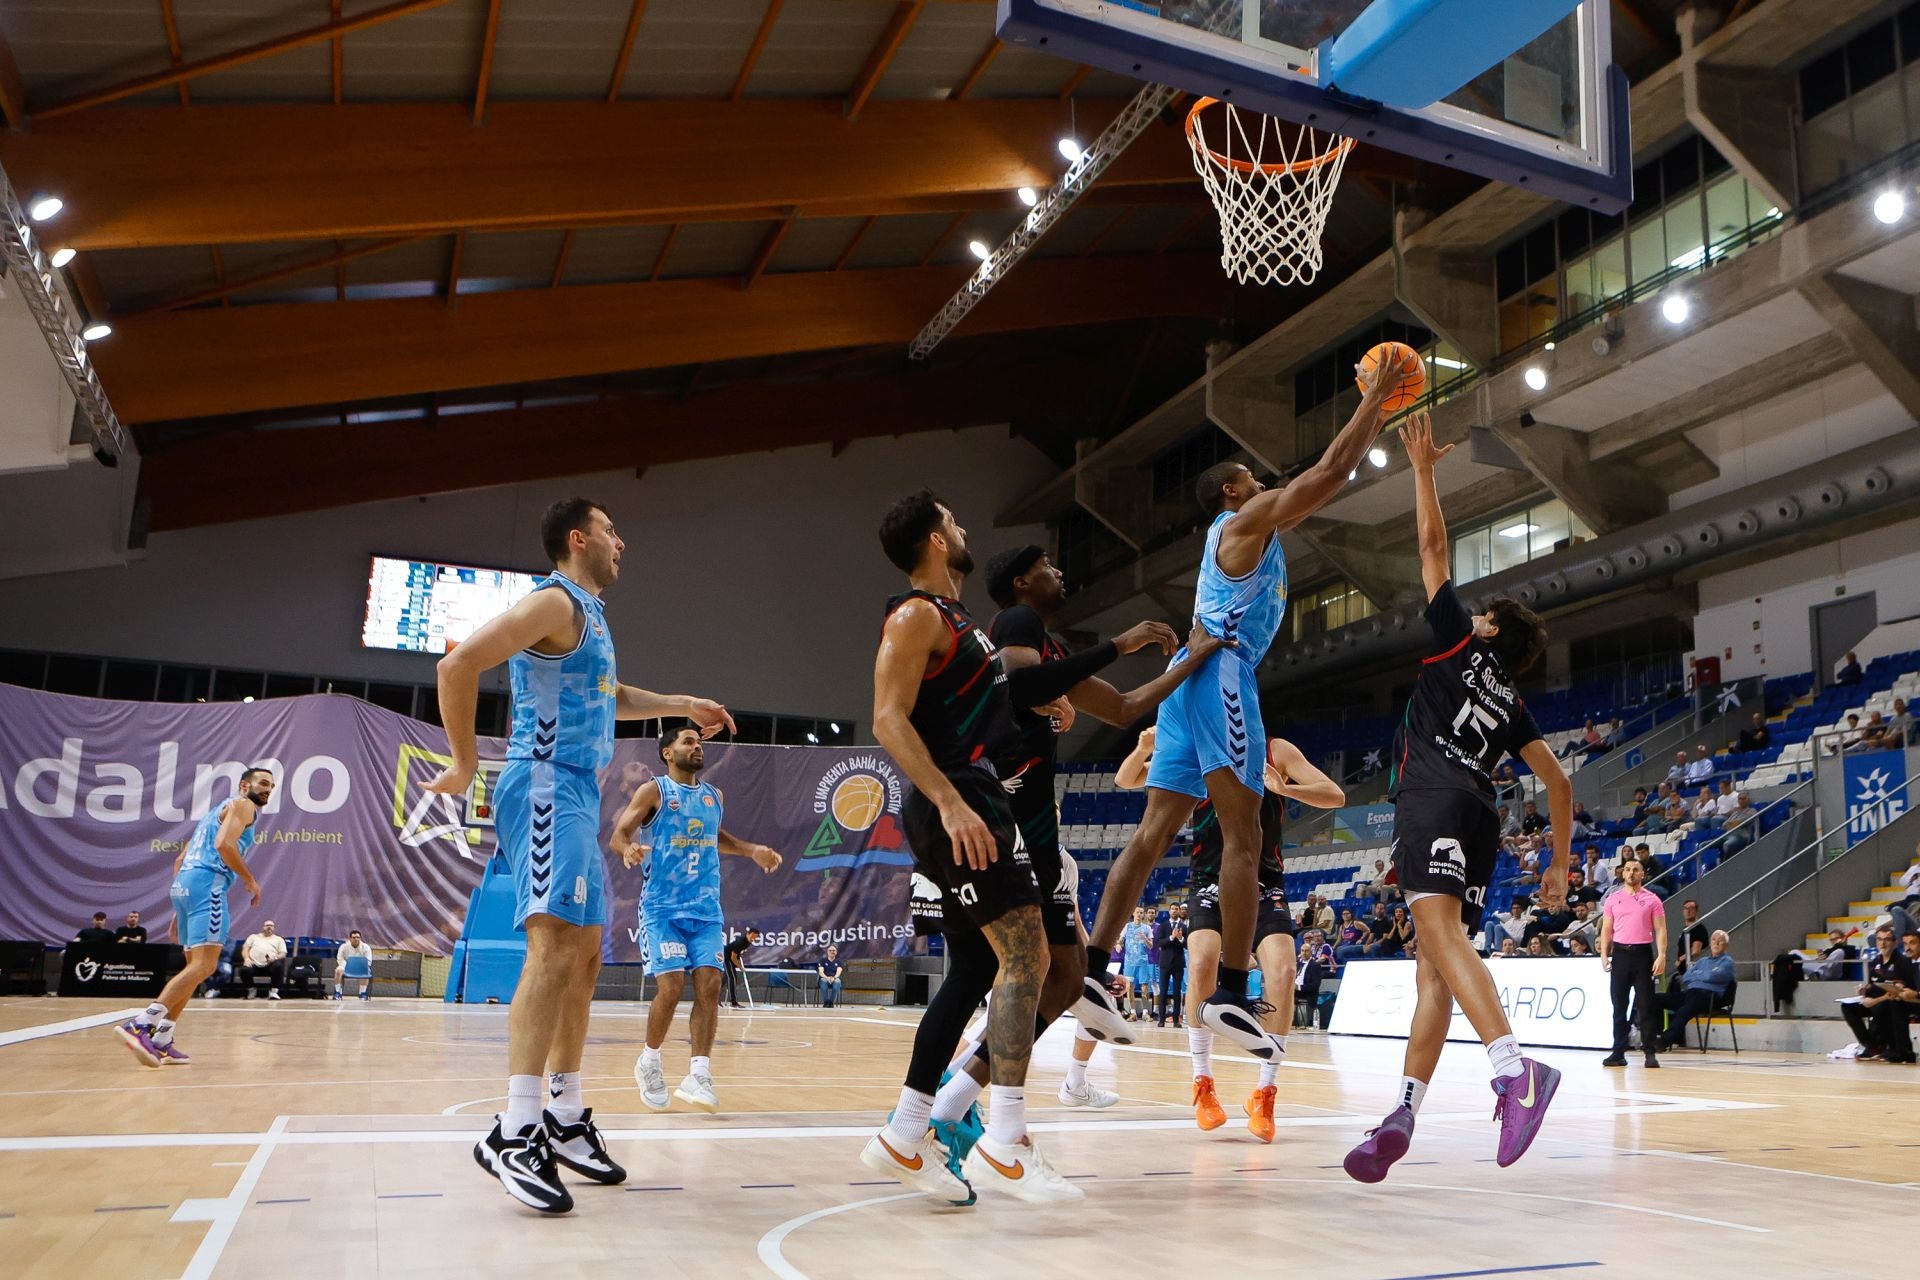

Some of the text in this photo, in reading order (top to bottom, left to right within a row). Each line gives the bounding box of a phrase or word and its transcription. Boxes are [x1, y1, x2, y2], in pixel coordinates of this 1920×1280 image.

[0, 738, 351, 823] dalmo
[814, 754, 903, 815] CB IMPRENTA BAHÍA SAN AGUSTÍN
[150, 838, 184, 853] Resi
[272, 828, 344, 845] Ambient
[687, 852, 700, 875] 2
